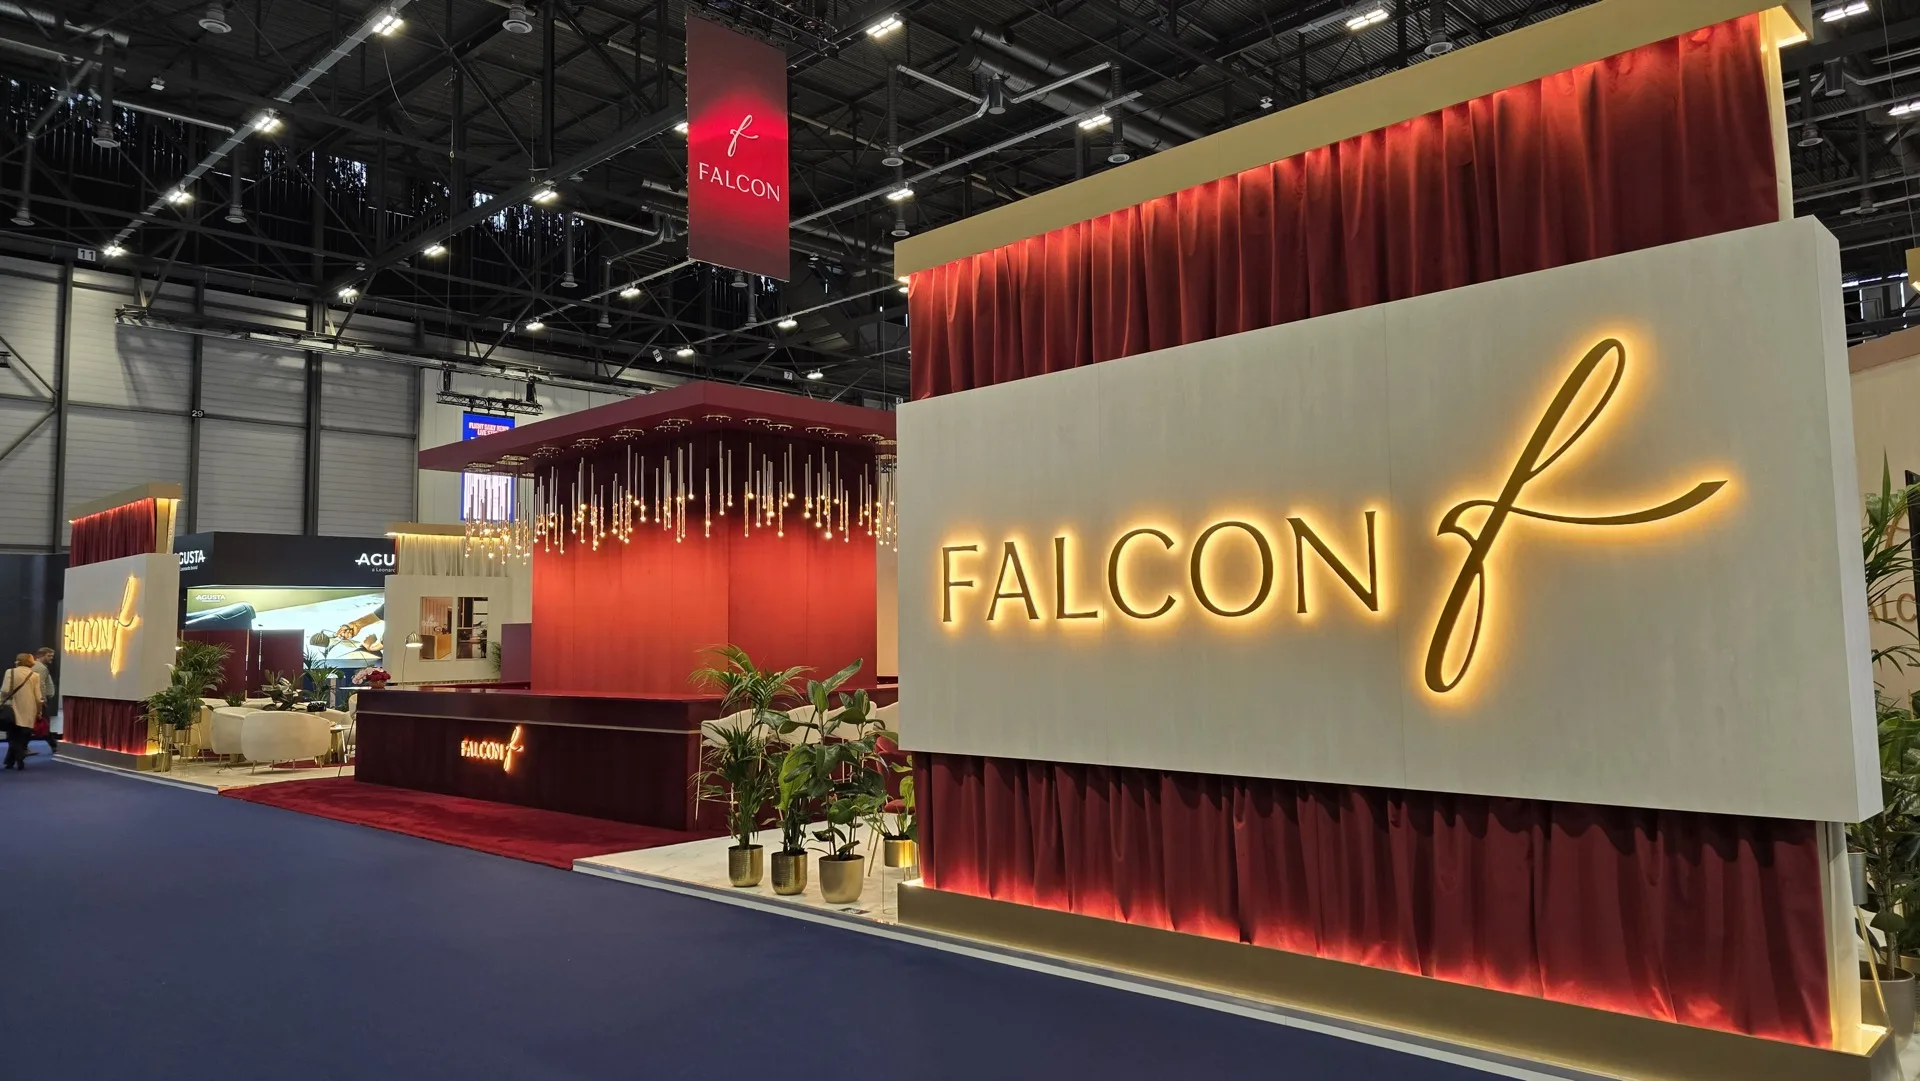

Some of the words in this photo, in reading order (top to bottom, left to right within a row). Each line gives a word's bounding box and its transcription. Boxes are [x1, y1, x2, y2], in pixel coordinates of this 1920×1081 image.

[699, 161, 780, 202] FALCON
[80, 249, 94, 260] 11
[191, 409, 204, 418] 29
[175, 549, 206, 565] GUSTA
[942, 510, 1381, 623] FALCON
[196, 593, 226, 601] AGUSTA
[64, 616, 114, 652] FALCON
[461, 740, 504, 760] FALCON
